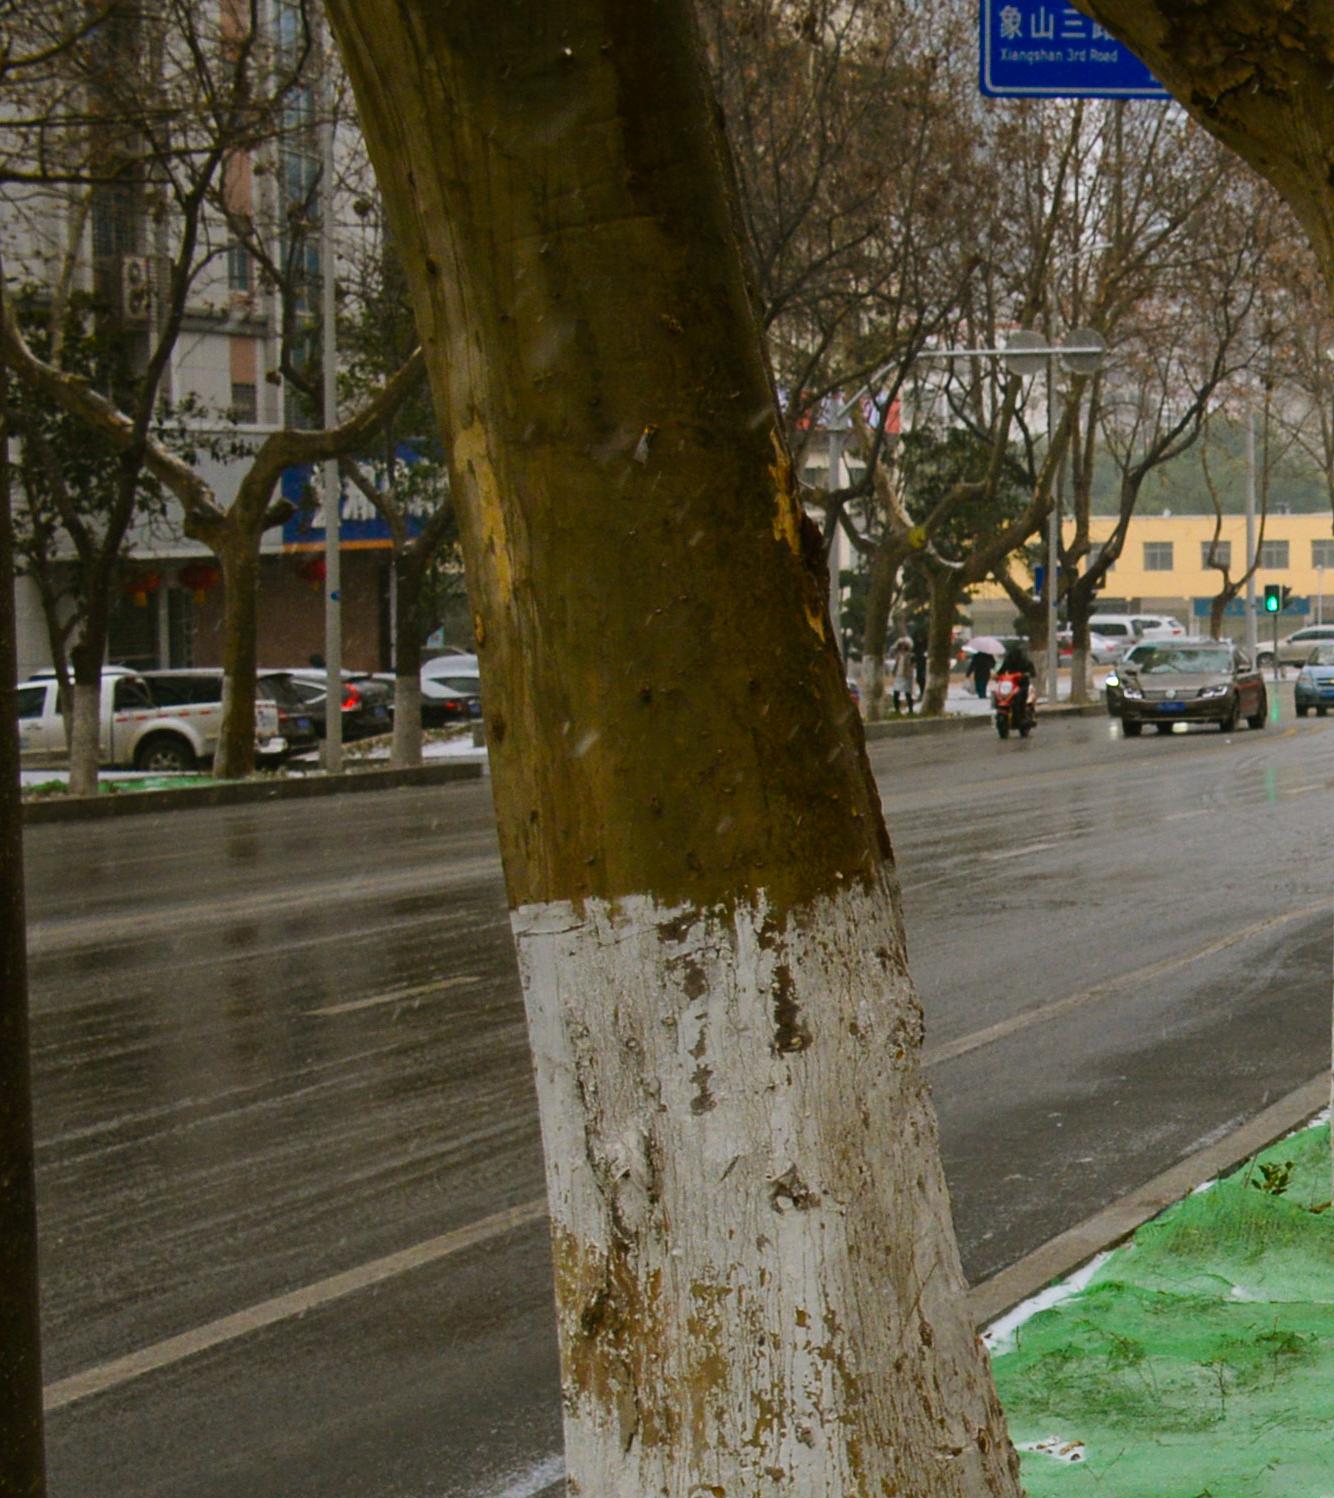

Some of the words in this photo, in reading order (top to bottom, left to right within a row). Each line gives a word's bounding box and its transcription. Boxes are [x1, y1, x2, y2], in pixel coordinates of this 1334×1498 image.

[1000, 48, 1064, 65] Xiangshan
[1066, 48, 1086, 63] 3rd
[1090, 48, 1119, 64] Road
